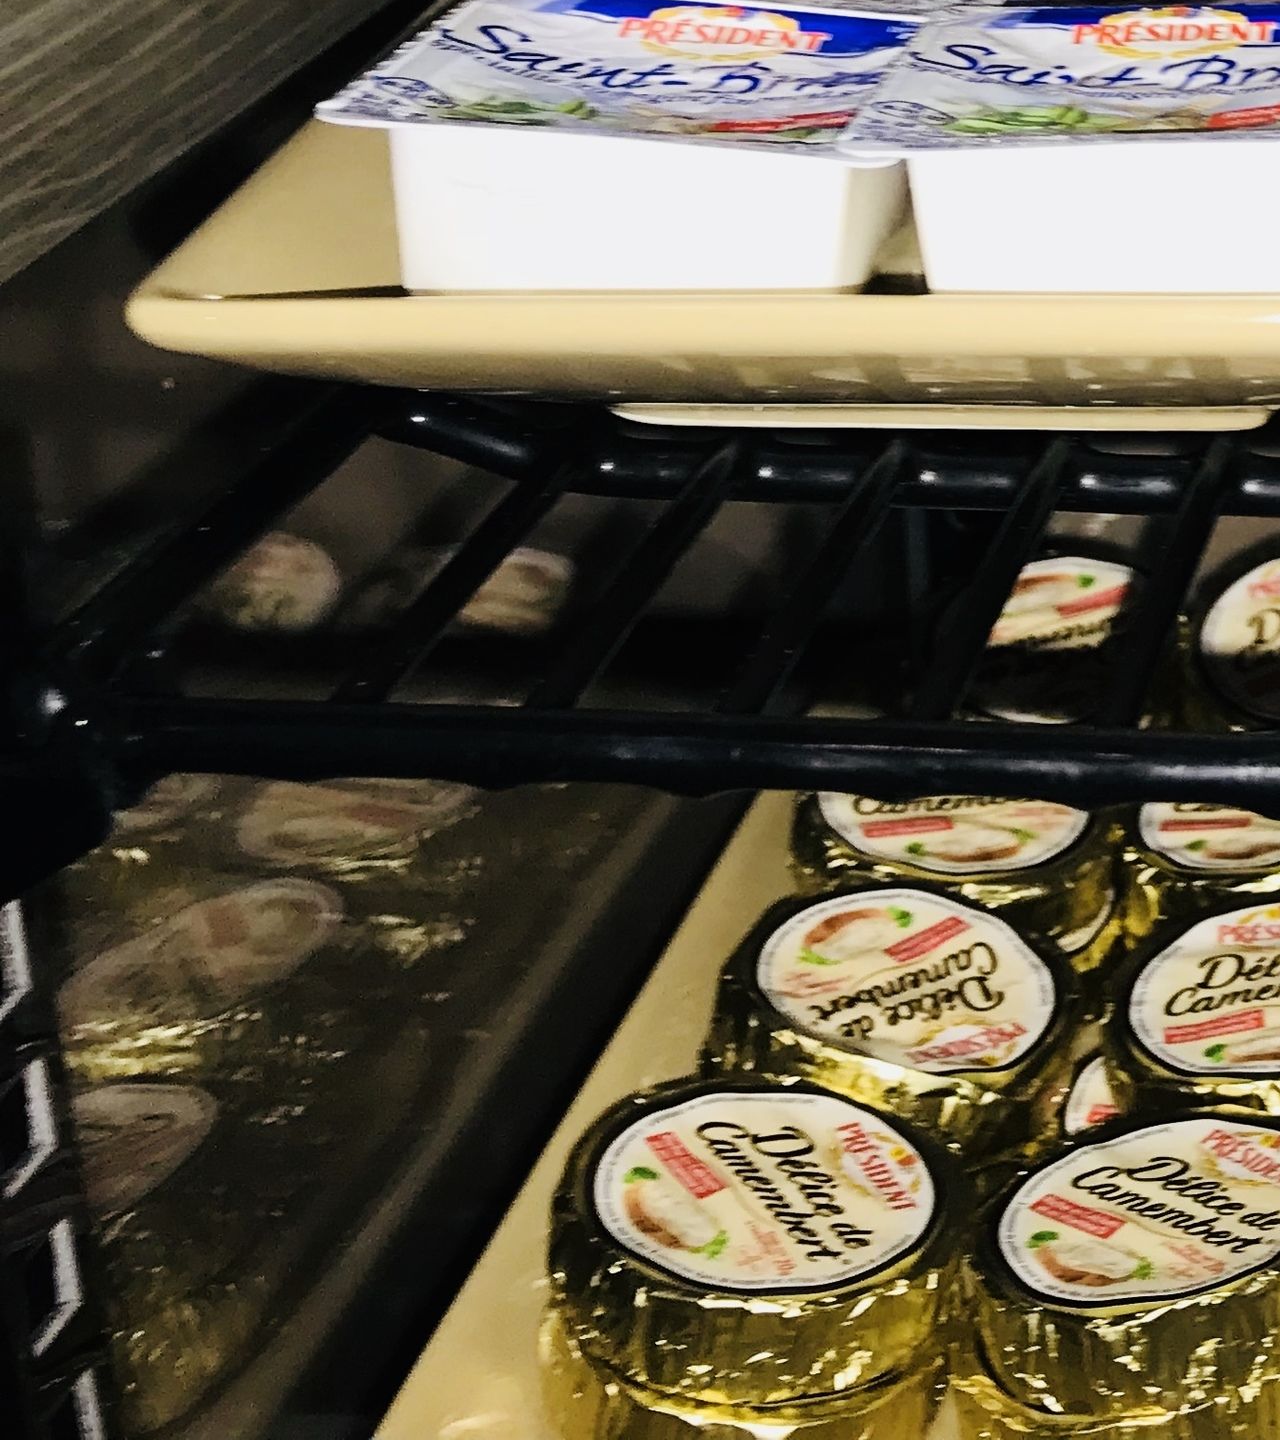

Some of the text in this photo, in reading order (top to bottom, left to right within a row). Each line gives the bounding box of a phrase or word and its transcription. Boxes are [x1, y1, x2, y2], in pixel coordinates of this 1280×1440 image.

[618, 16, 833, 51] PRÉSIDENT
[696, 1120, 844, 1263] Camembert
[750, 1125, 846, 1218] Délice
[828, 1221, 874, 1250] de
[836, 1121, 918, 1211] PRÉSIDENT
[1071, 1165, 1264, 1255] Camembert
[1124, 1155, 1250, 1217] Délice
